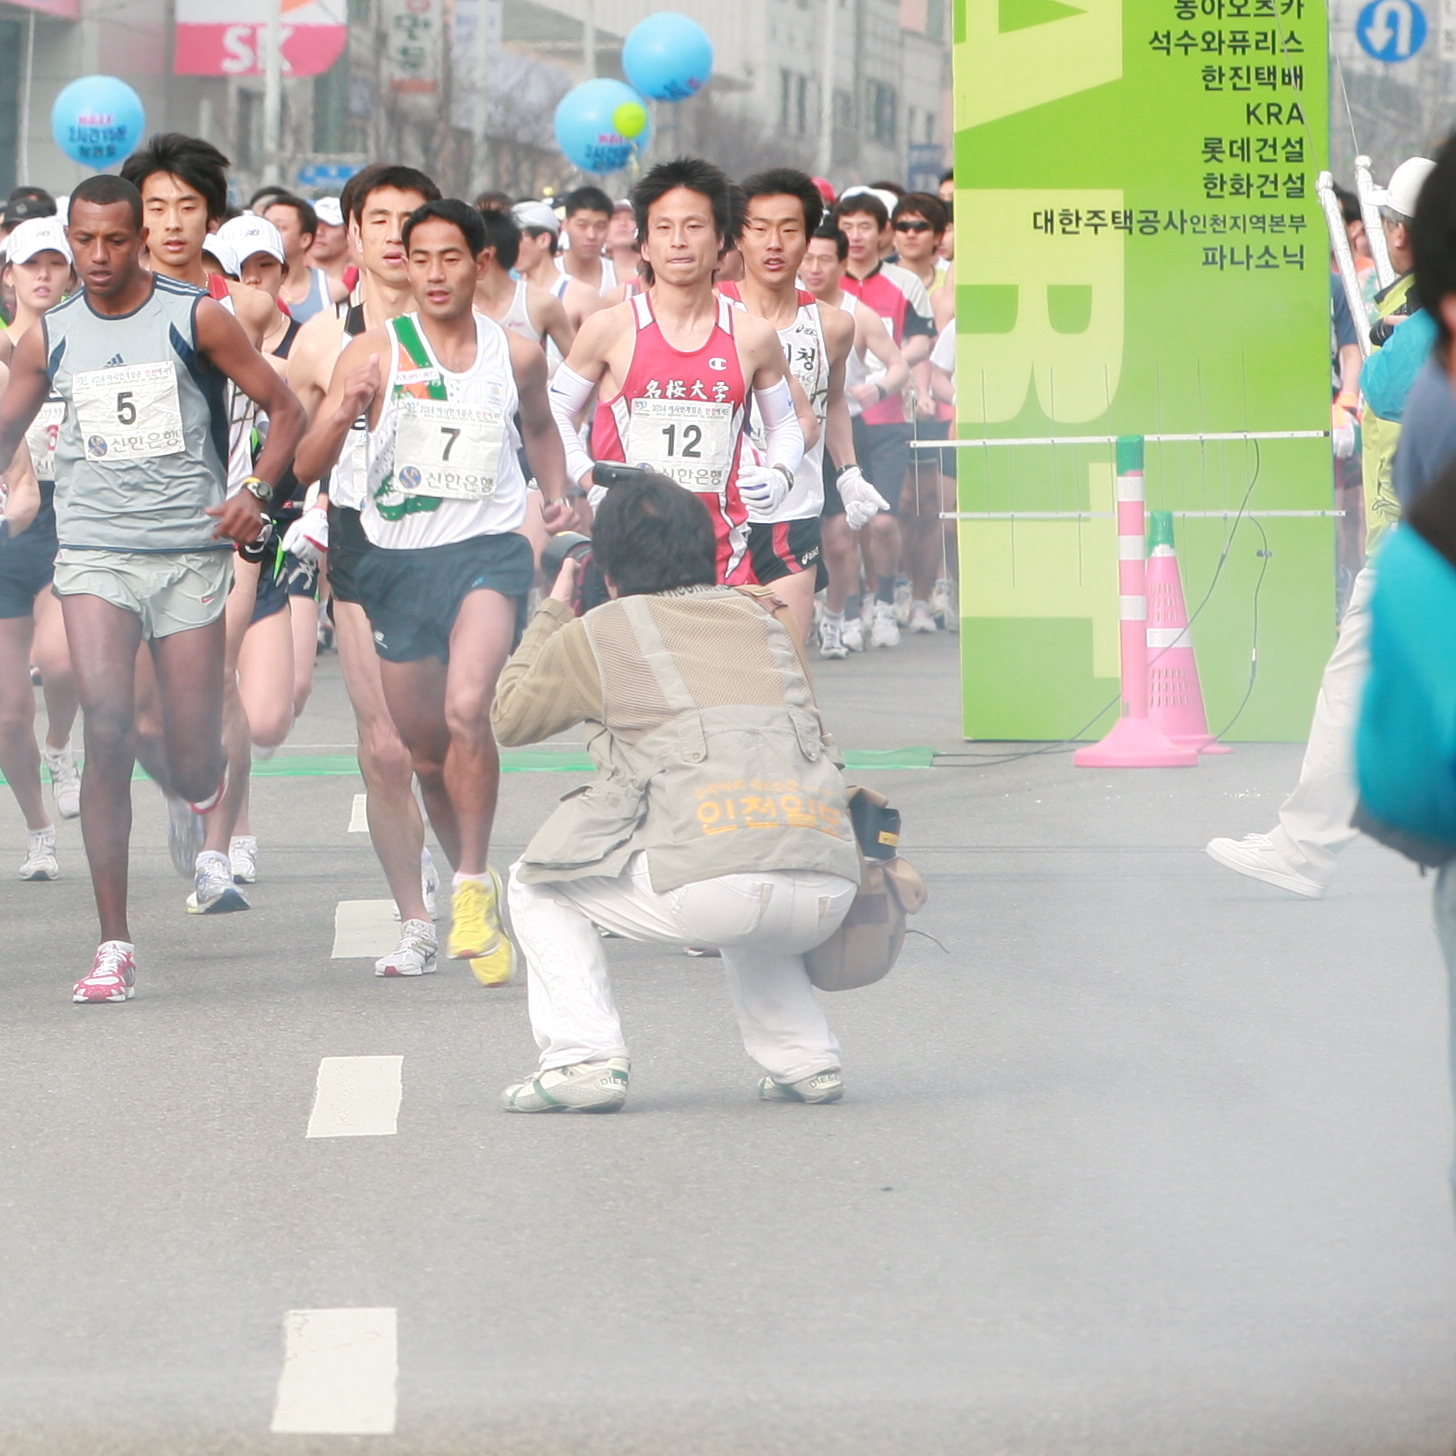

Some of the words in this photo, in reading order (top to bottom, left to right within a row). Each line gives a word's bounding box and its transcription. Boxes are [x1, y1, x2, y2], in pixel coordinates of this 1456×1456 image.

[1149, 30, 1304, 56] 석수와퓨리스
[1201, 66, 1304, 92] 한진택배
[1246, 102, 1304, 125] KRA
[1202, 136, 1305, 164] 롯데건설
[1203, 173, 1306, 200] 한화건설
[1202, 245, 1305, 271] 파나소닉
[117, 392, 137, 425] 5
[111, 430, 180, 453] 신한은행
[440, 426, 461, 462] 7
[662, 424, 702, 458] 12
[427, 472, 494, 494] 신한은행
